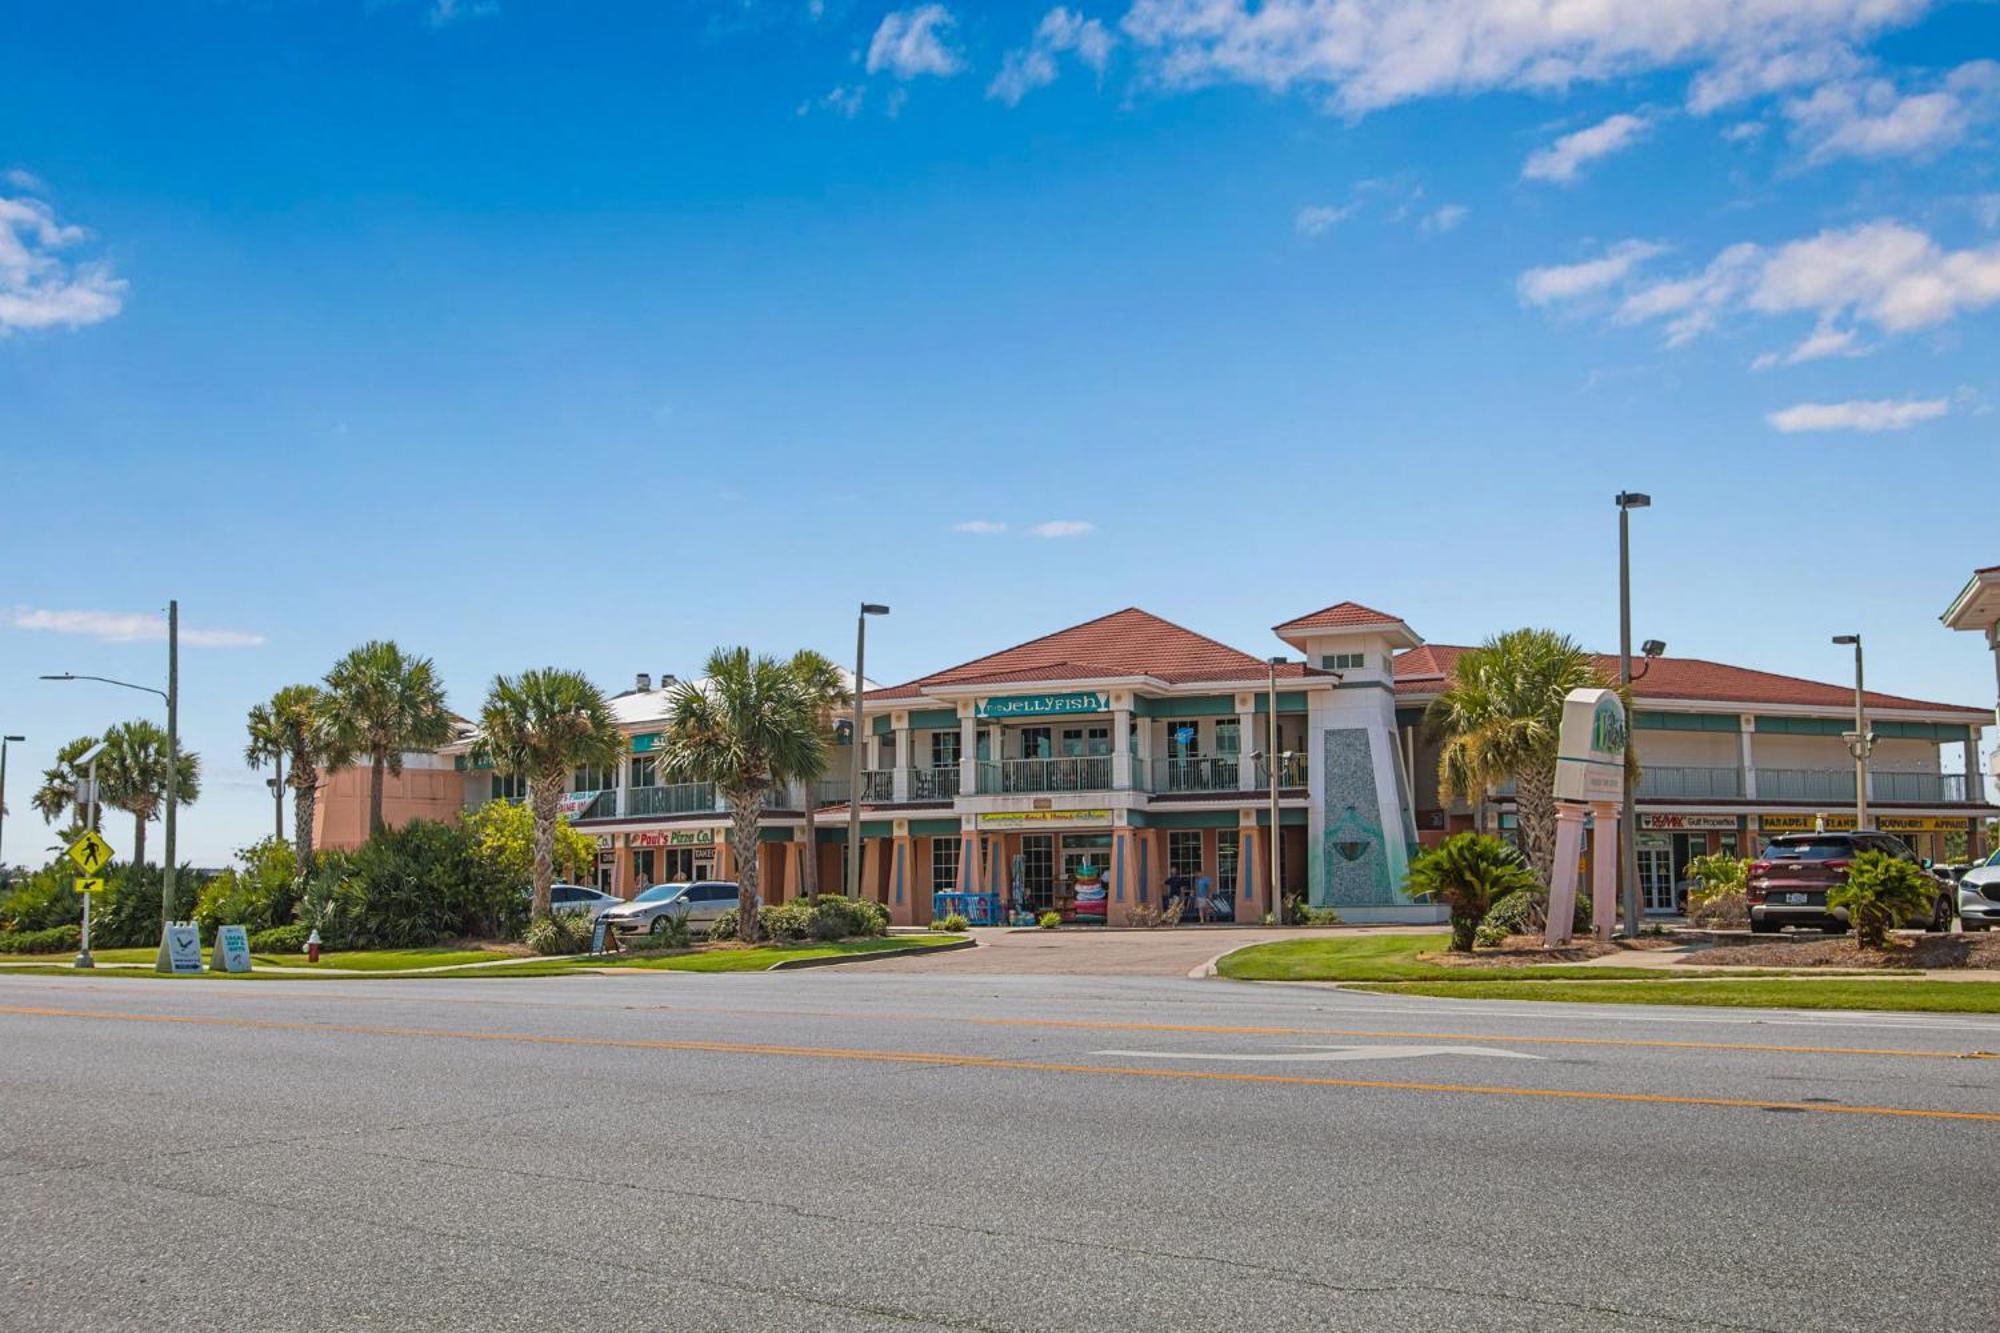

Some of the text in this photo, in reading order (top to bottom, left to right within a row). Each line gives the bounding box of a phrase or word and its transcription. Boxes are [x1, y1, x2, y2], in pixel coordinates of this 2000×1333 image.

[1687, 817, 1702, 826] Gulf
[1703, 817, 1736, 827] Properties
[640, 833, 669, 845] Paul's
[671, 832, 695, 844] Pizza
